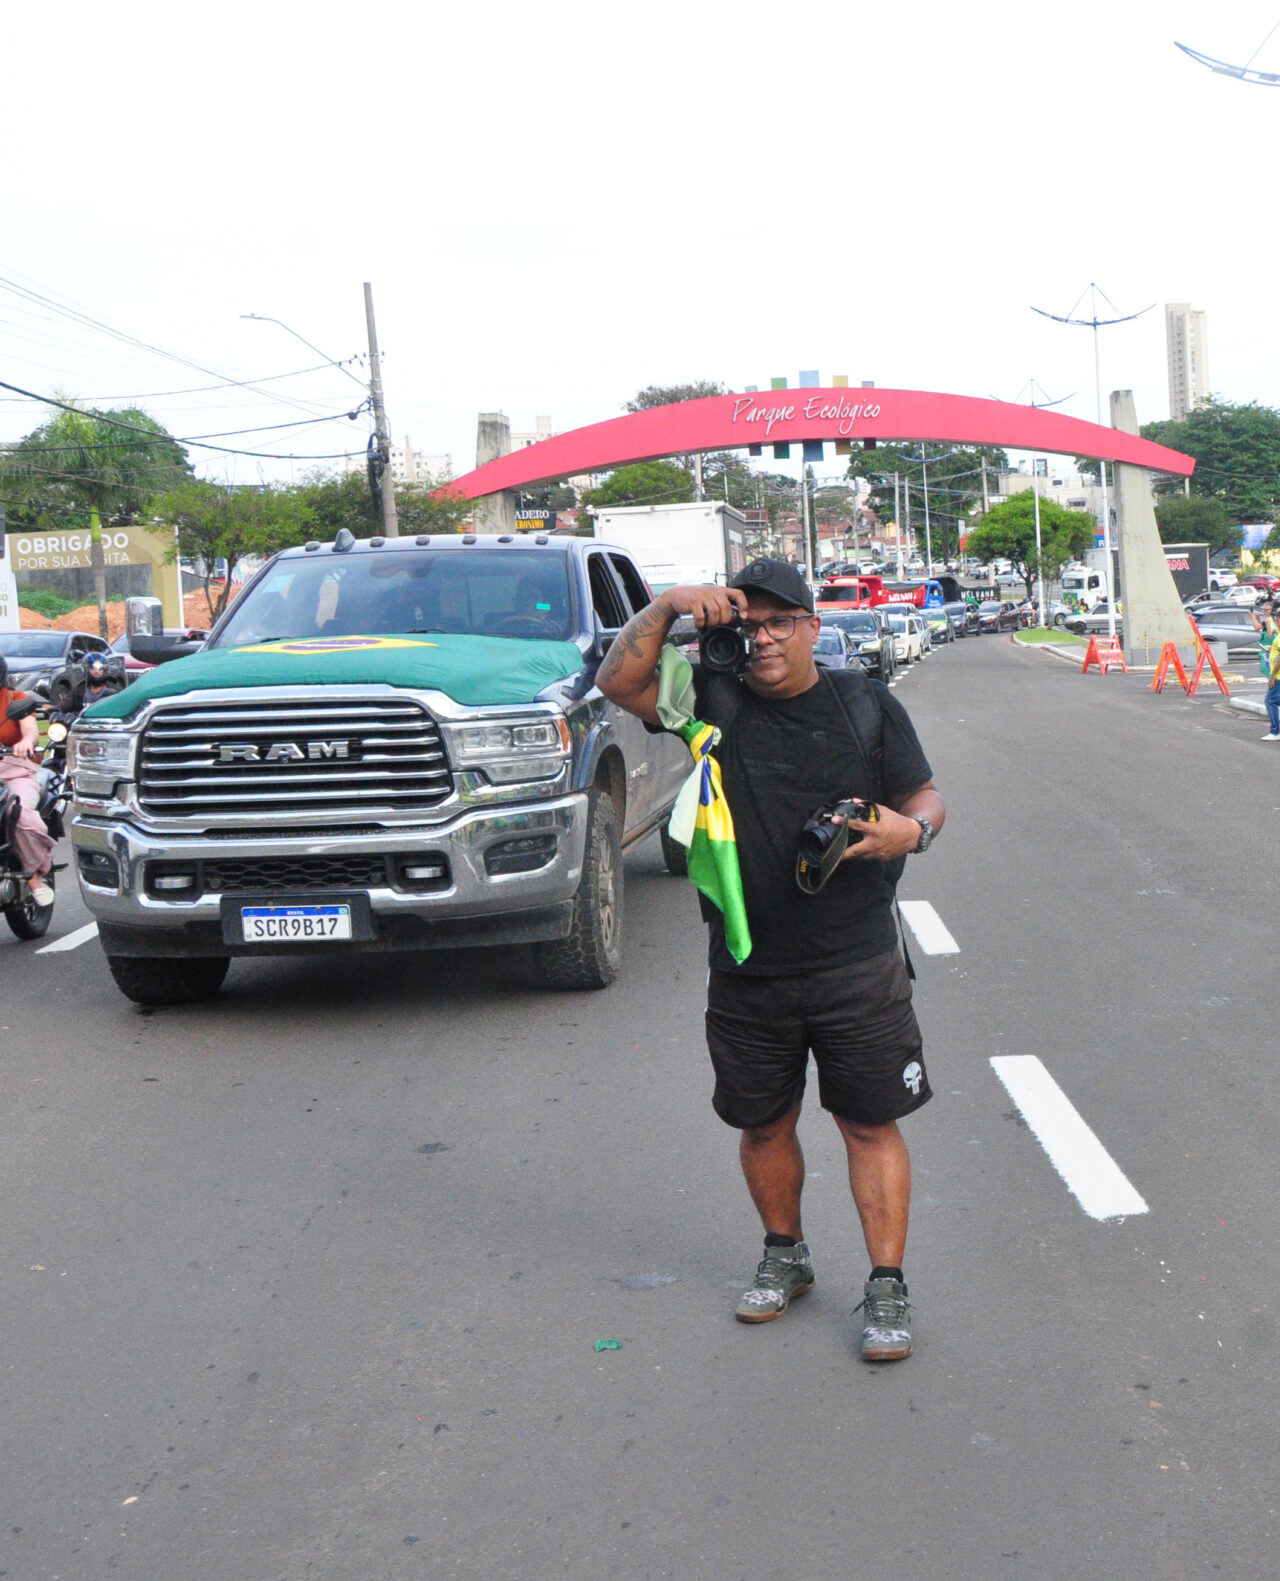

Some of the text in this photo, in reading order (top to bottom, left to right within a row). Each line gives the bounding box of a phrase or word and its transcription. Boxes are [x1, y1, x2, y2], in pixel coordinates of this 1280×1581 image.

[733, 396, 881, 435] Parque Ecológico
[514, 510, 549, 519] ADERO
[18, 551, 131, 569] POR SUA VSITA
[219, 741, 349, 761] RAM
[254, 917, 338, 937] SCR9B17
